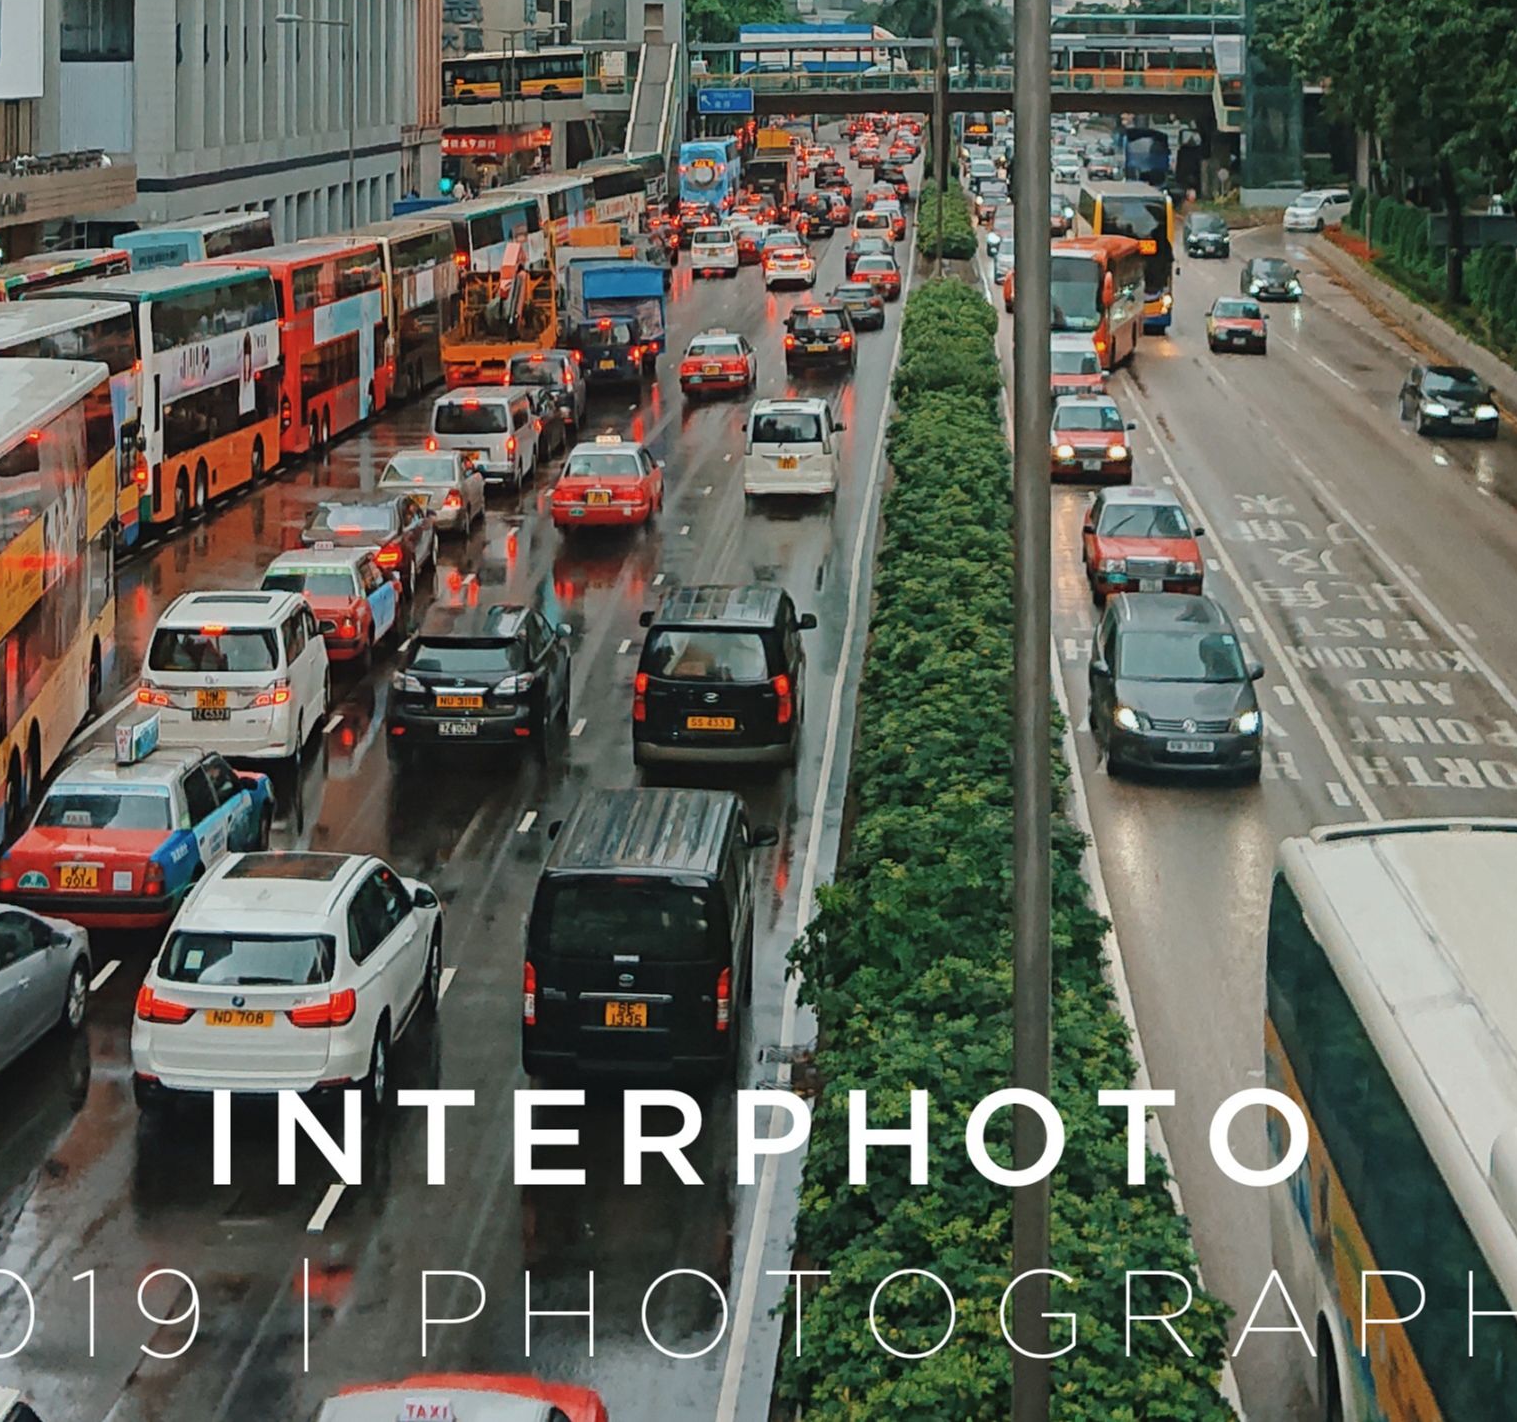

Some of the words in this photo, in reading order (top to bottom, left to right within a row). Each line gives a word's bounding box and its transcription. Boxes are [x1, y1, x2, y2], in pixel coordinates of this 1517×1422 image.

[1282, 644, 1481, 674] KOWLOON
[1348, 678, 1456, 706] AND
[238, 1010, 265, 1025] 708
[405, 1403, 448, 1420] TAXI
